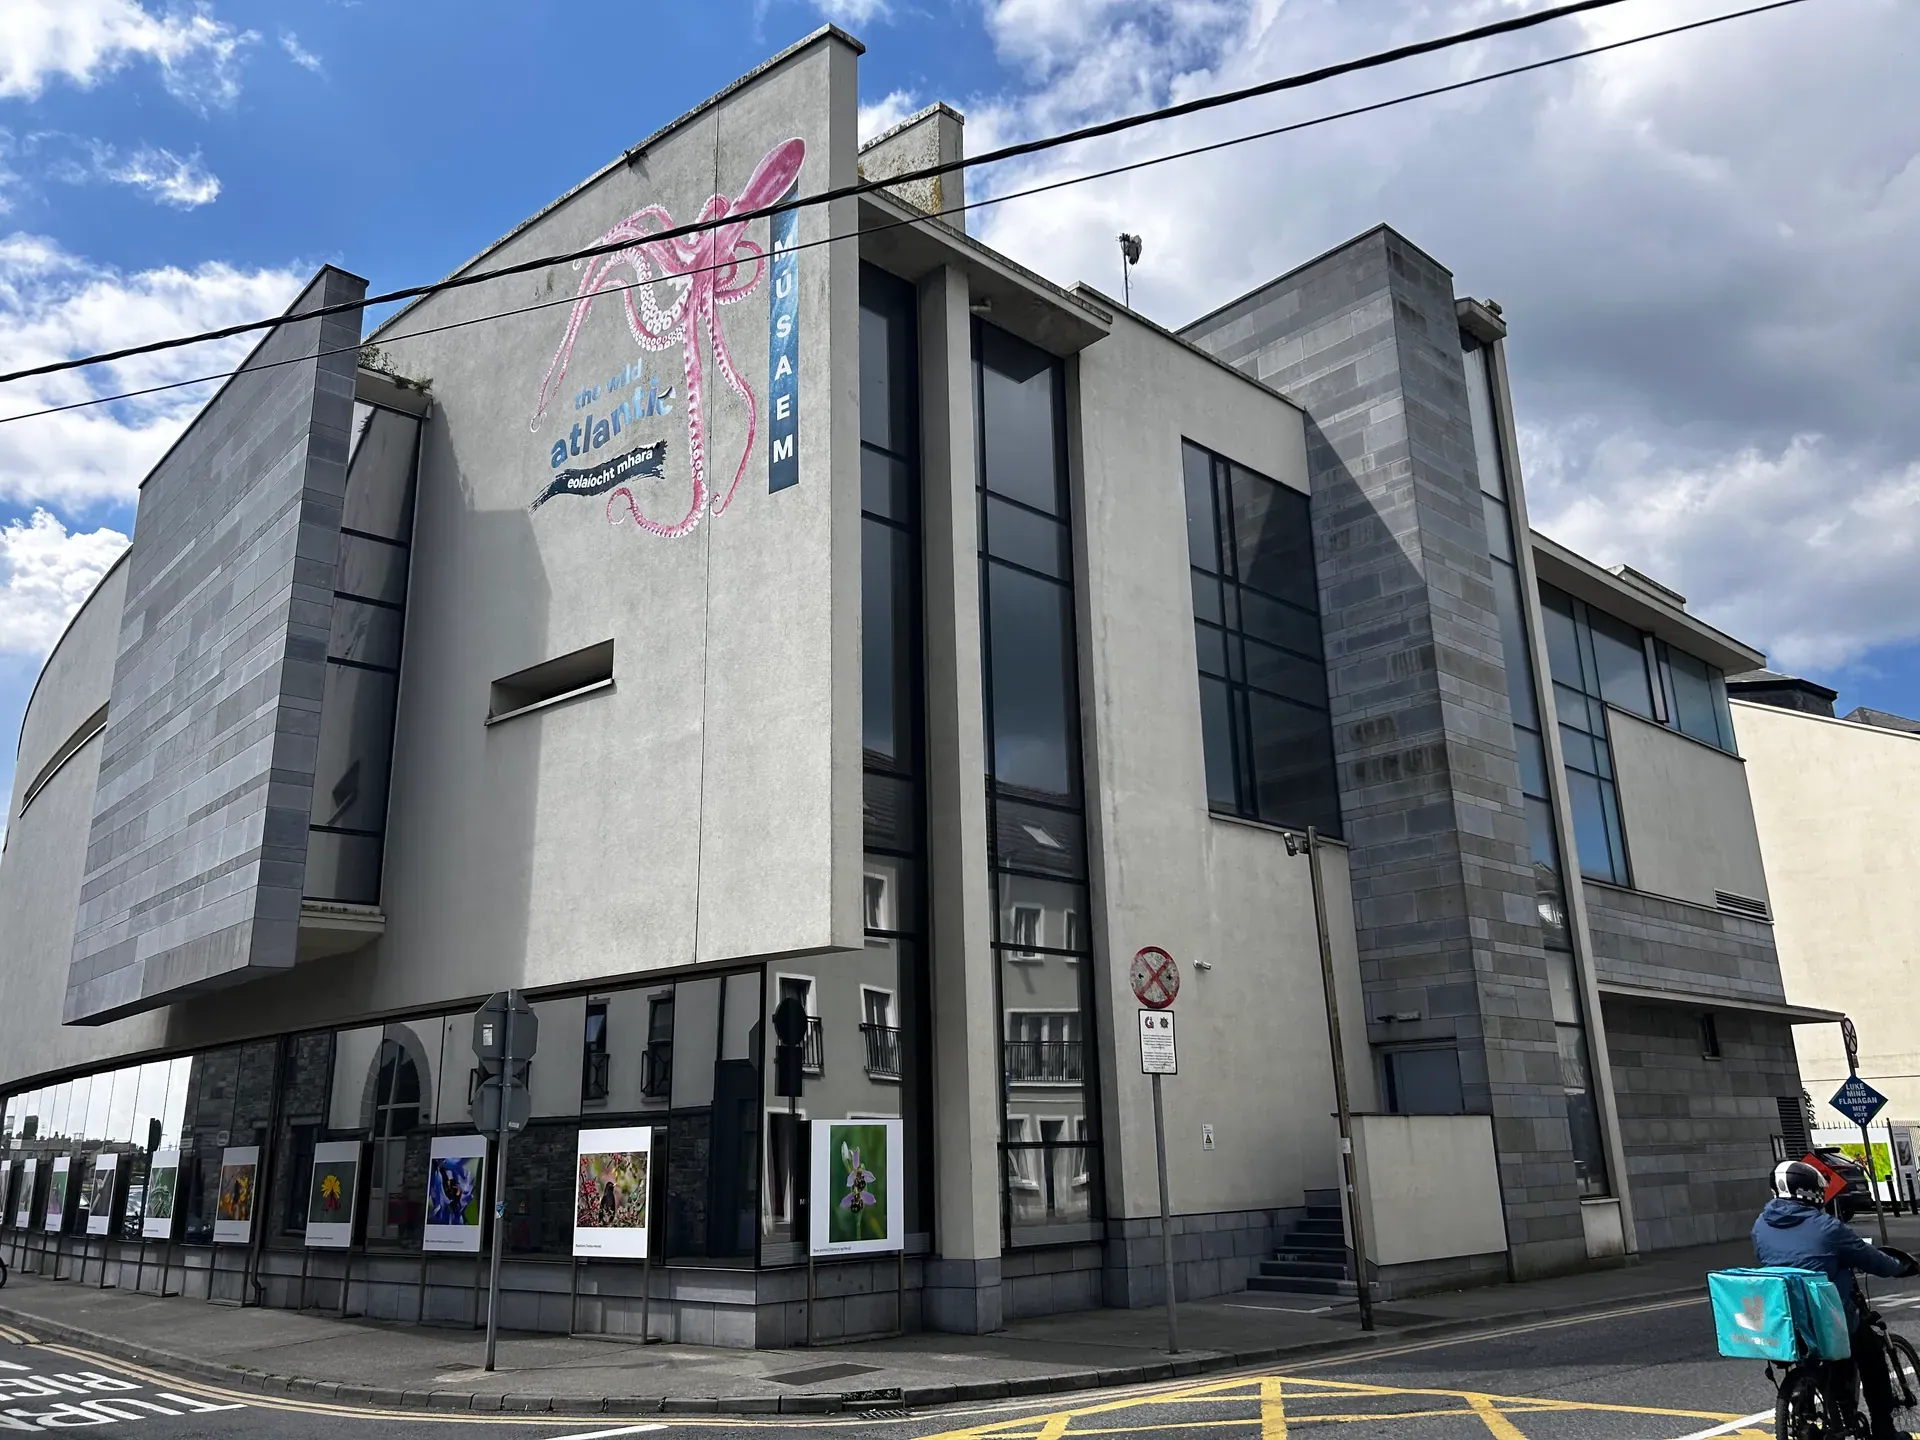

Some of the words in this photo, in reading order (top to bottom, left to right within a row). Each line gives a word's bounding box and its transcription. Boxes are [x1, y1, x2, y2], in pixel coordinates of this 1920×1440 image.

[773, 232, 794, 464] MÚSAEM
[574, 383, 602, 411] the
[606, 357, 643, 394] wild
[551, 376, 677, 469] atlantic
[567, 467, 615, 489] eolaíocht
[617, 449, 653, 475] mhara
[1838, 1097, 1877, 1105] FLANAGAN
